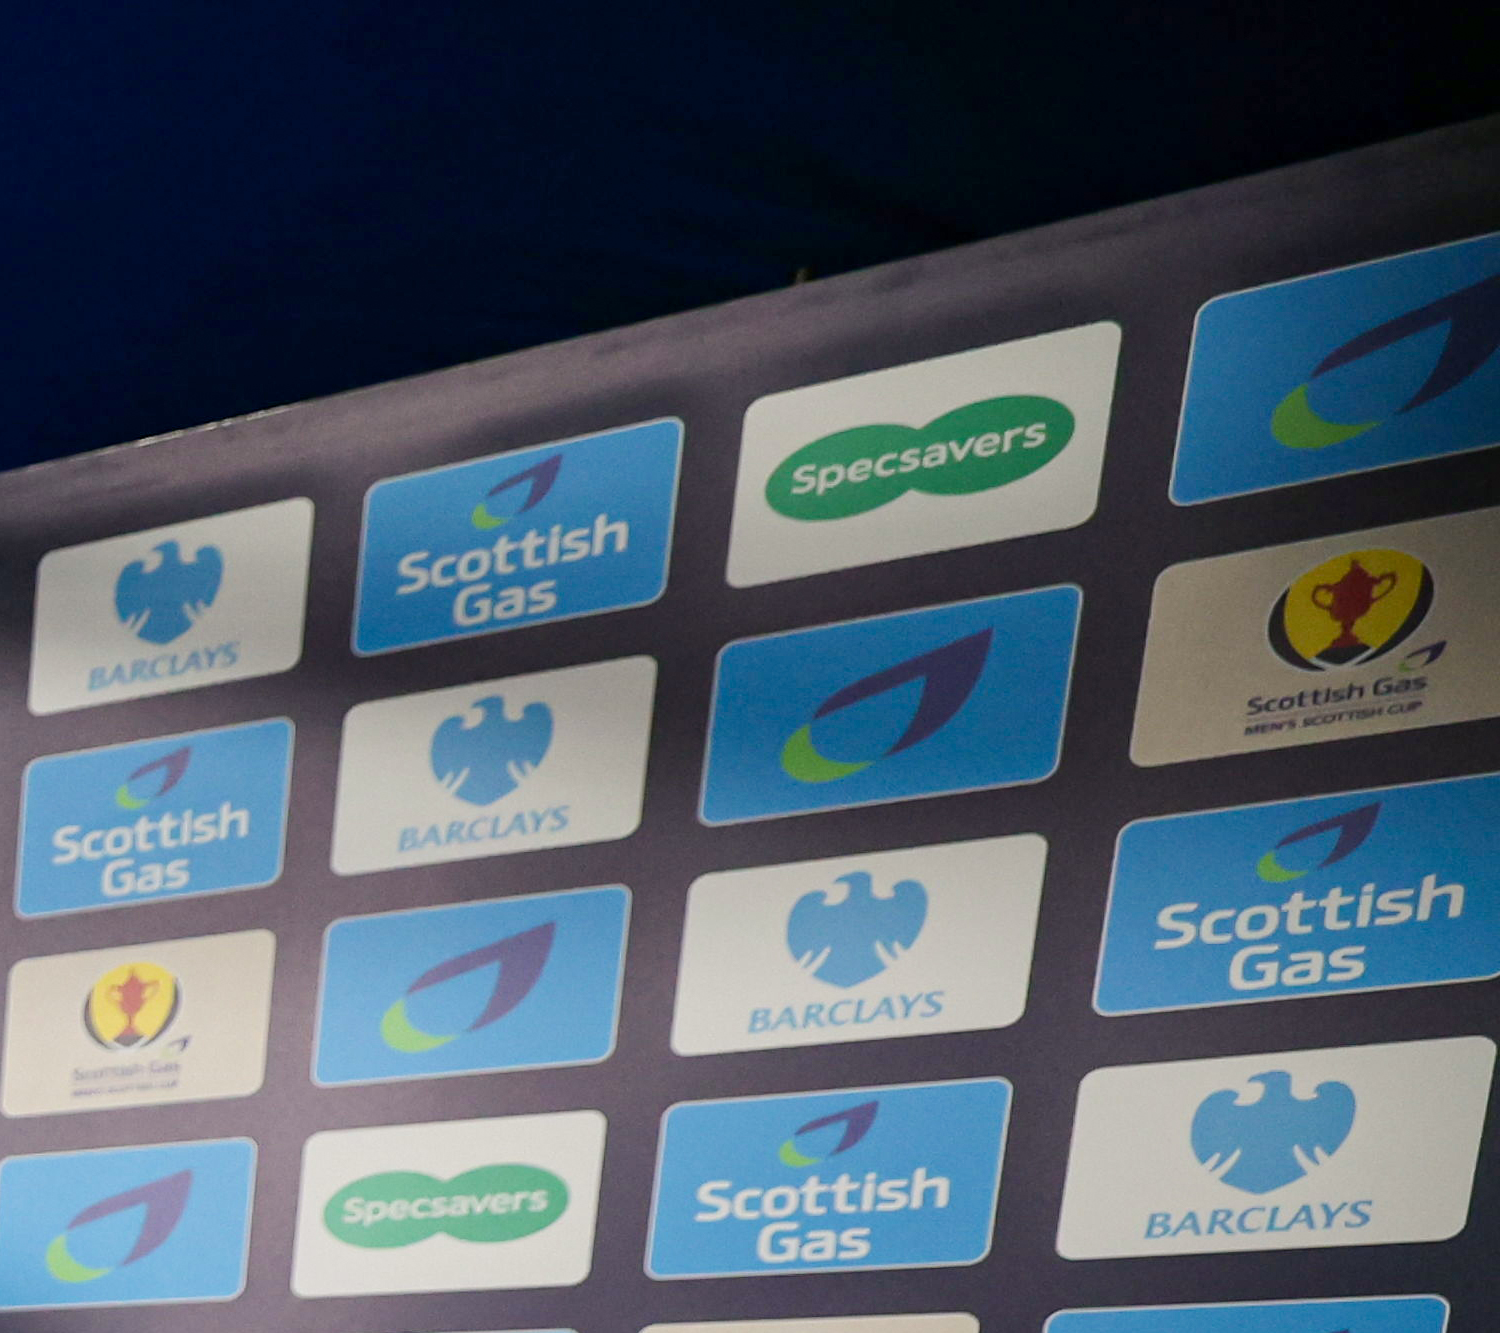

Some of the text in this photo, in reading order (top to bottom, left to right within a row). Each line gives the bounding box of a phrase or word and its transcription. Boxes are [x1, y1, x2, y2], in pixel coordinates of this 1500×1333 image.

[790, 420, 1047, 496] Specsavers
[395, 514, 629, 596] Scottish
[453, 580, 557, 628] Gas
[87, 641, 242, 692] BARCLAYS
[1243, 700, 1423, 736] MEN'S SCOTTISH CUP
[1245, 671, 1429, 718] Scottish Gas
[51, 803, 250, 865] Scottish
[398, 806, 570, 853] BARCLAYS
[102, 858, 190, 896] Gas
[1153, 874, 1466, 952] Scottish
[1227, 943, 1367, 992] Gas
[747, 990, 946, 1036] BARCLAYS
[342, 1187, 548, 1228] Specsavers
[694, 1167, 950, 1223] Scottish
[756, 1222, 872, 1264] Gas
[1142, 1201, 1373, 1241] BARCLAYS
